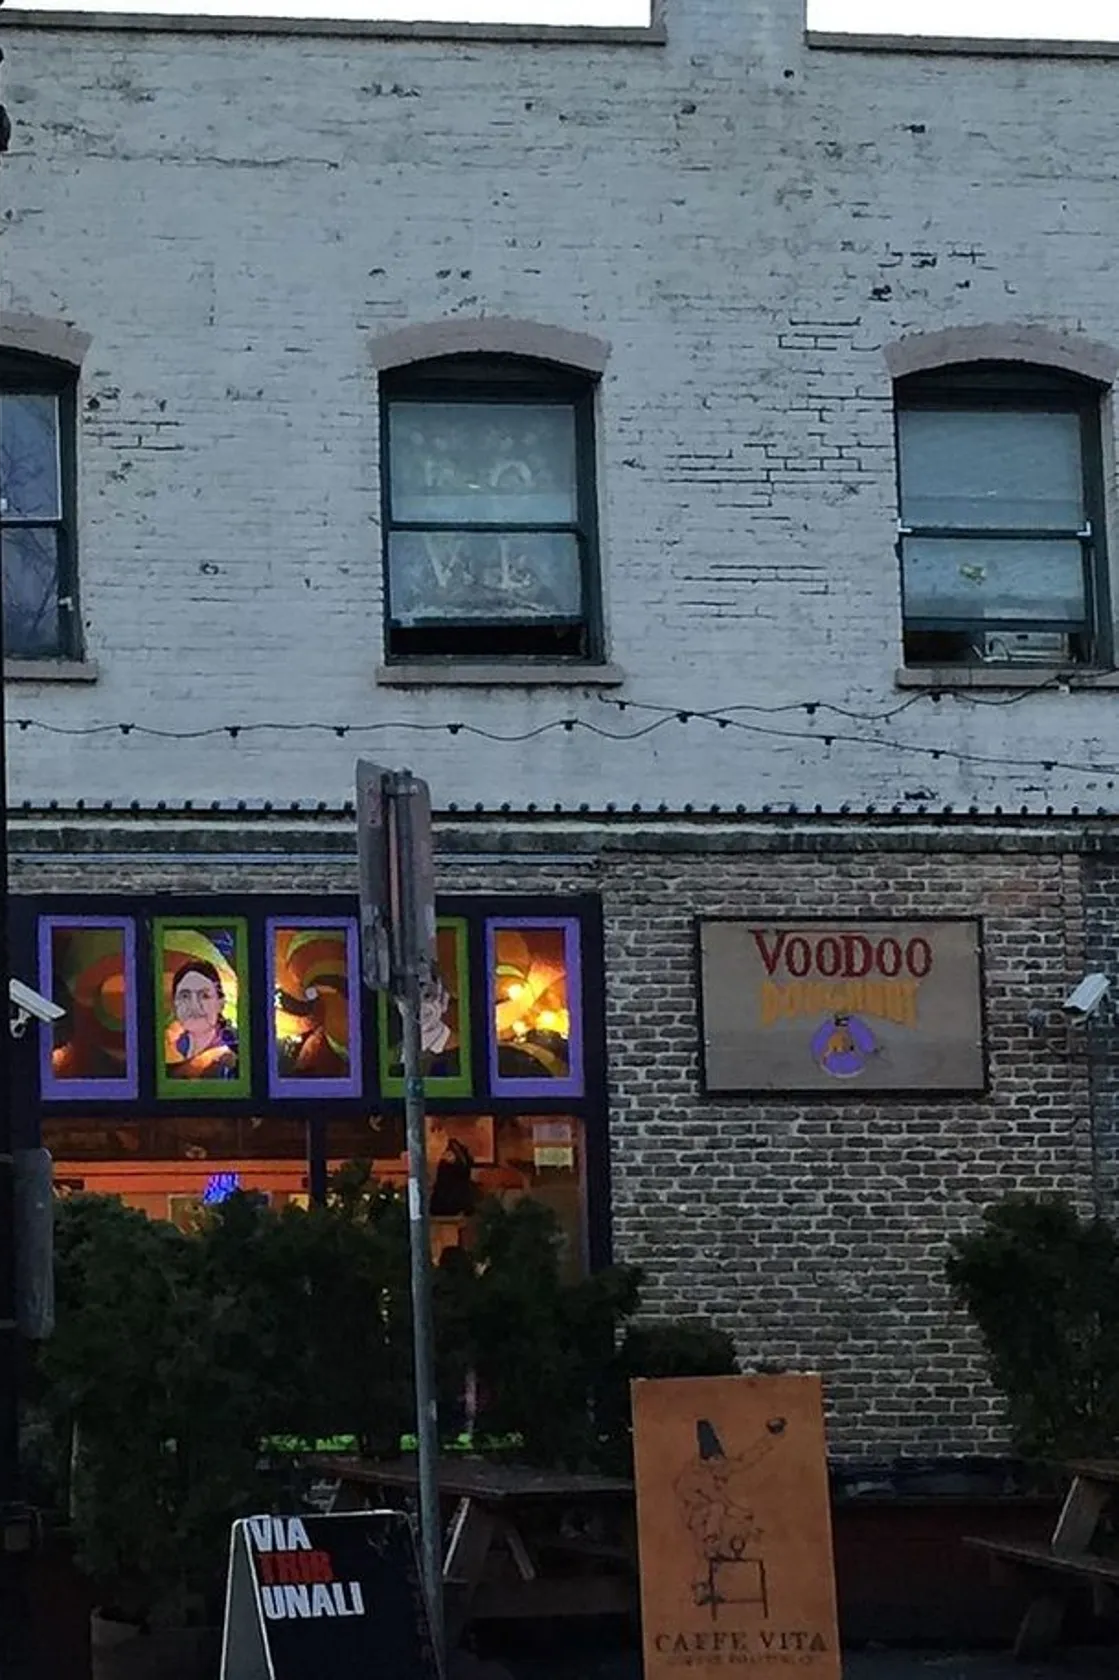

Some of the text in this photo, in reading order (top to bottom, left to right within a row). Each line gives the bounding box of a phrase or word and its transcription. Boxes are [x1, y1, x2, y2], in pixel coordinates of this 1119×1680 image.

[750, 929, 933, 978] VOODOO
[249, 1516, 312, 1551] VIA
[261, 1581, 365, 1620] UNALI
[655, 1631, 830, 1653] CAFFE VITA
